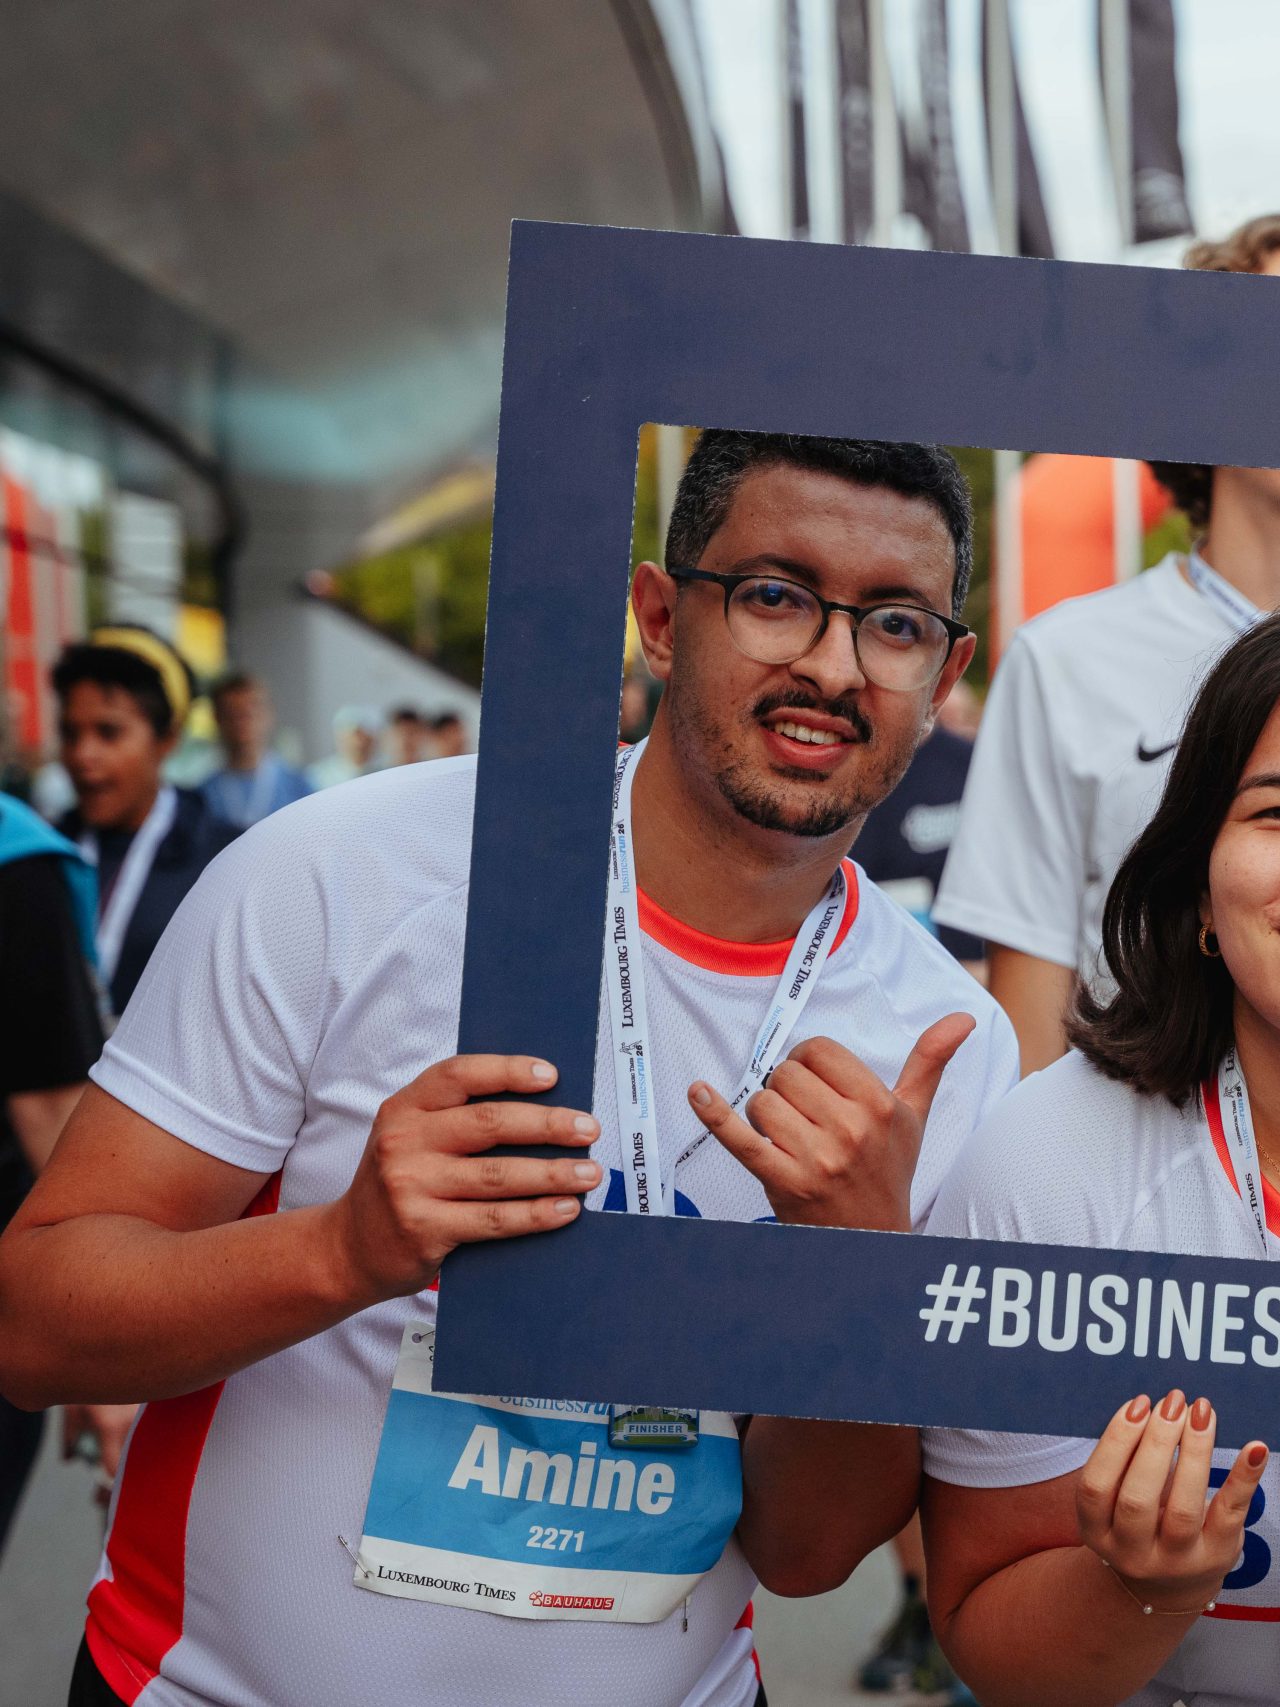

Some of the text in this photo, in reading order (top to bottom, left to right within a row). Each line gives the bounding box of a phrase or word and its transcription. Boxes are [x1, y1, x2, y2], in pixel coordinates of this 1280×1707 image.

[803, 904, 839, 967] LUXEMBOURG
[613, 906, 634, 1028] LUXEMBOURG TIMES
[789, 967, 812, 1000] TIMES
[636, 1044, 644, 1056] 26
[633, 1132, 650, 1214] BOURG TIMES
[500, 1396, 610, 1416] usinessru
[628, 1424, 683, 1434] FINISHER
[448, 1424, 676, 1515] Amine
[526, 1525, 585, 1553] 2271
[377, 1565, 516, 1602] LUXEMBOURG TIMES
[543, 1594, 615, 1610] BAUHAUS
